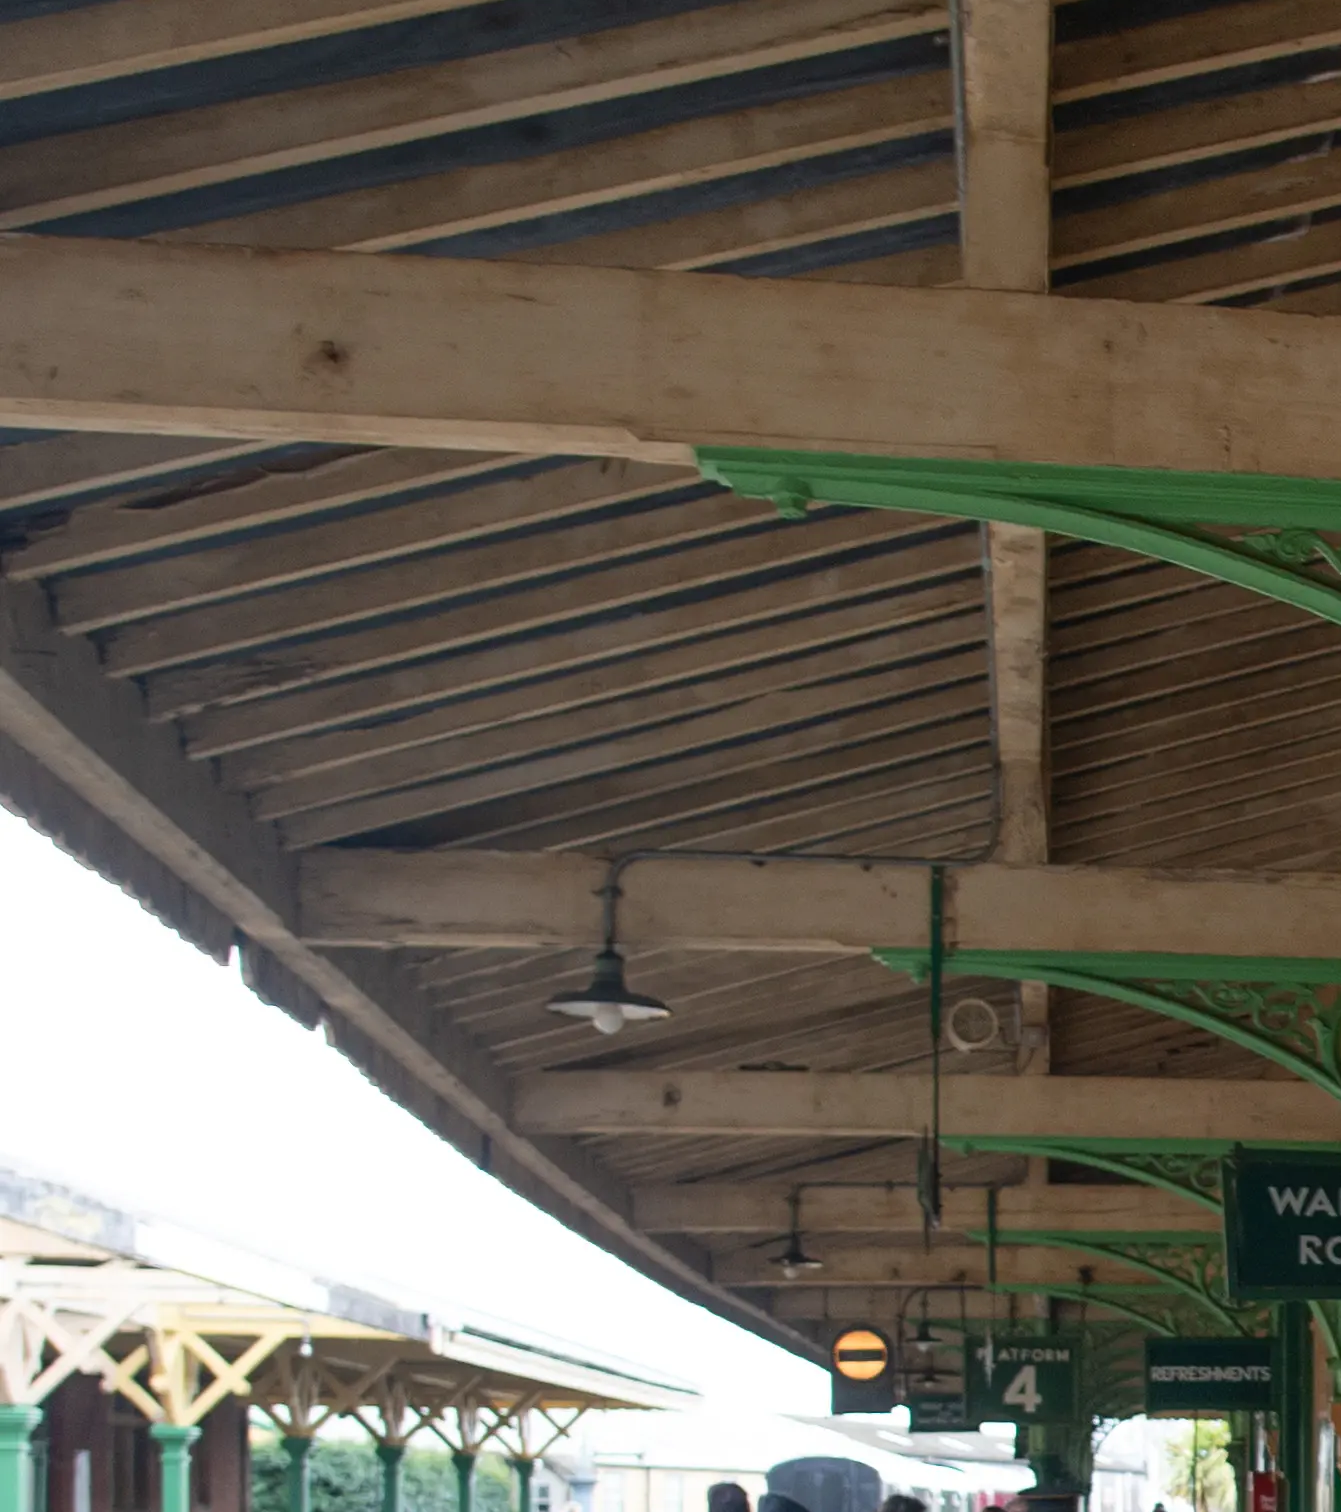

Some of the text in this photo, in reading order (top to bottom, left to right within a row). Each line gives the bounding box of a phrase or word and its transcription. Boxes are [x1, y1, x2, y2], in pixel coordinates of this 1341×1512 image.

[975, 1347, 1070, 1362] PATFORM
[1150, 1365, 1272, 1381] REFRESHMENTS
[1002, 1364, 1043, 1412] 4
